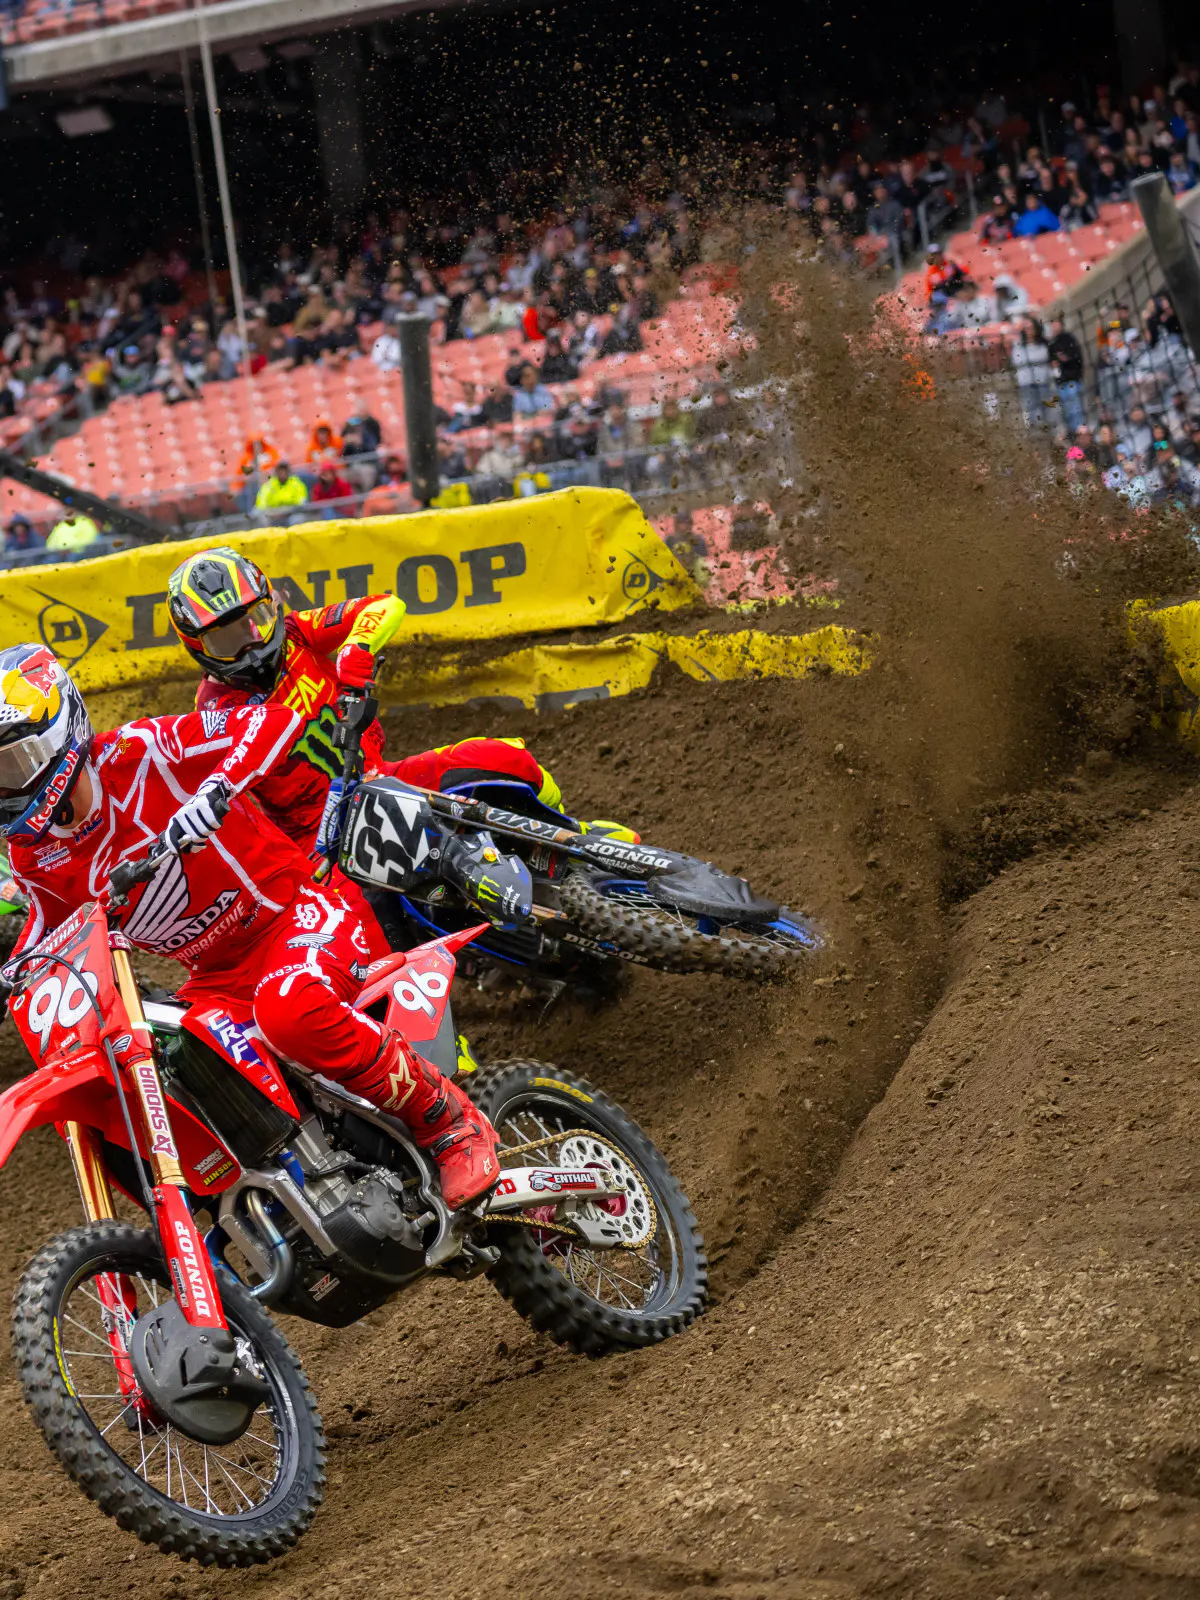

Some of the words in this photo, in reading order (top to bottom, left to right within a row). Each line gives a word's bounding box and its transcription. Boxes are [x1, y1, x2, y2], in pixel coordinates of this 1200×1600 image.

[125, 541, 527, 651] DNLOP
[282, 673, 326, 719] EAL
[25, 785, 58, 833] Red
[53, 748, 80, 793] Bull
[584, 842, 673, 869] DUNLOP
[146, 887, 242, 955] HONDA
[169, 900, 246, 963] PROGRESSIVE
[563, 932, 649, 964] DUOP
[28, 944, 99, 1057] 96
[392, 966, 450, 1020] 96
[207, 1009, 249, 1065] CRF
[138, 1066, 171, 1132] SHOWA
[193, 1148, 222, 1171] WORKS
[203, 1160, 234, 1187] HINSON
[174, 1220, 211, 1318] DUNLOP
